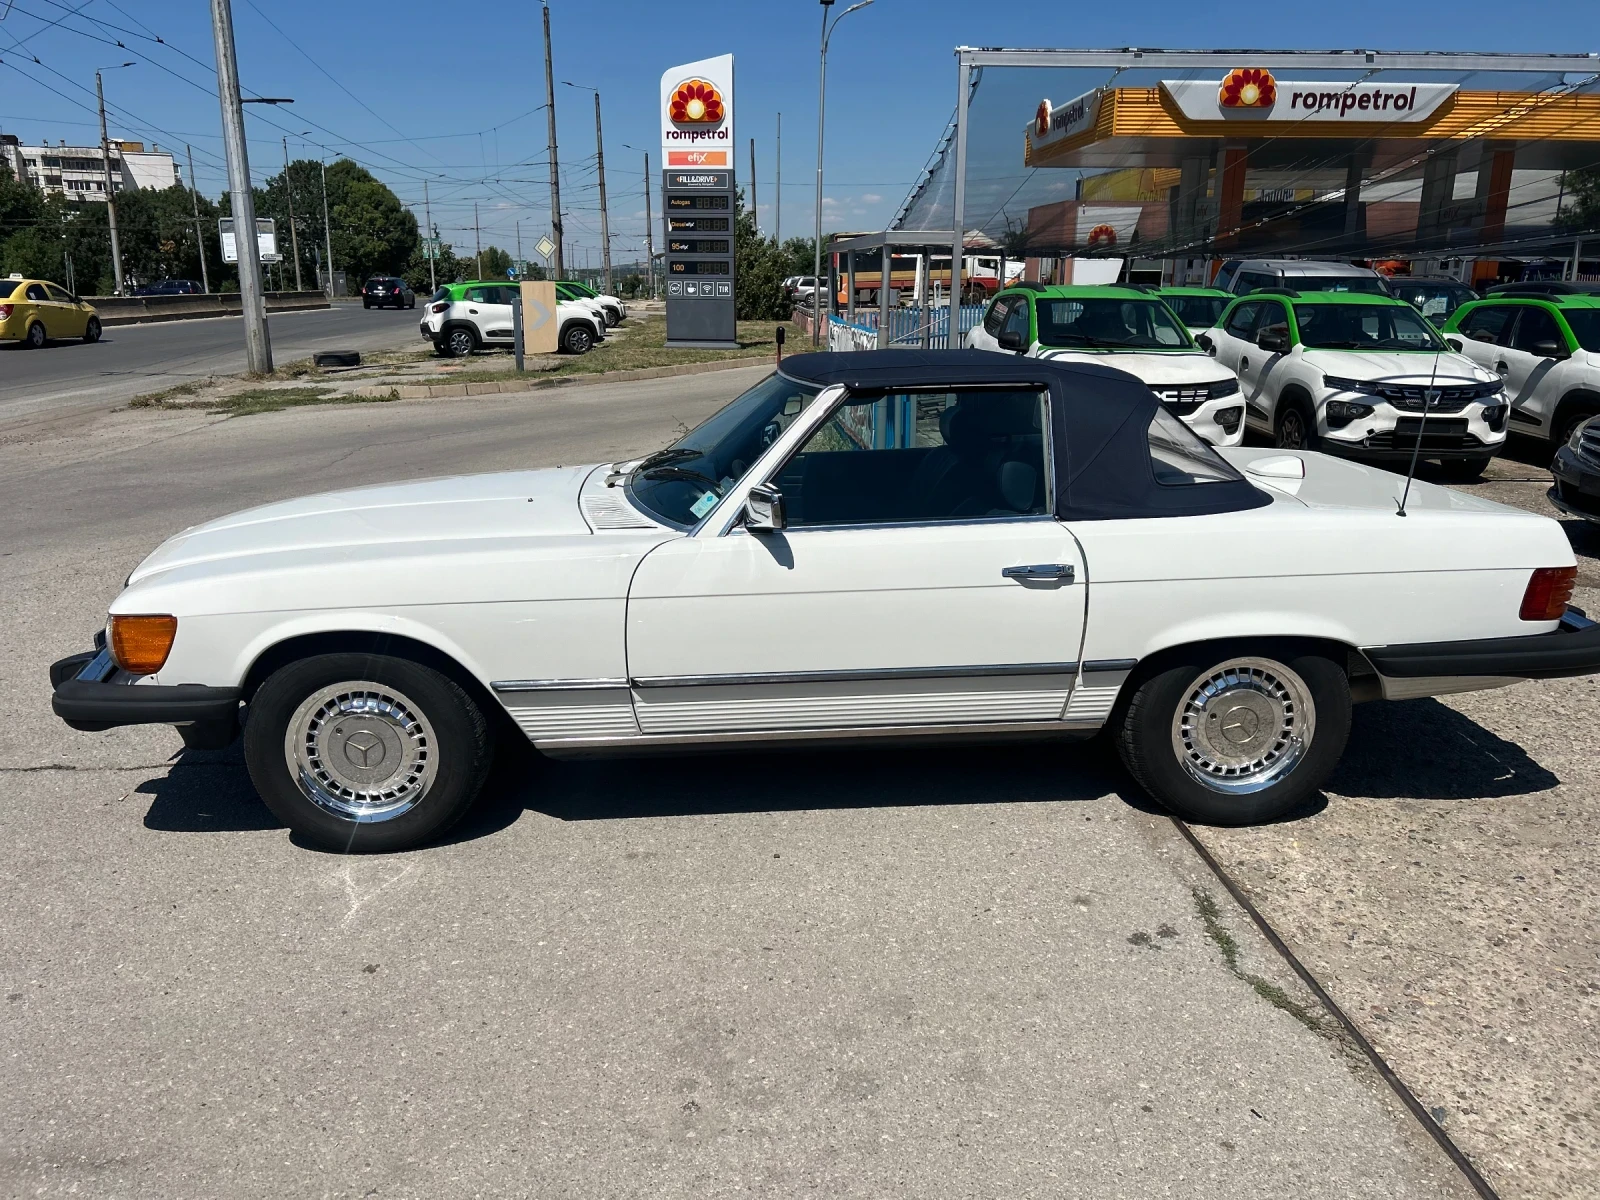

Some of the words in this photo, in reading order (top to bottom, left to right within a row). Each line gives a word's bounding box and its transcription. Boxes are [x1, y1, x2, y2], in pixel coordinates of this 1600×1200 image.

[1291, 86, 1416, 117] rompetrol
[1052, 97, 1084, 133] rompetrol
[666, 127, 728, 143] rompetrol
[688, 152, 708, 164] efix
